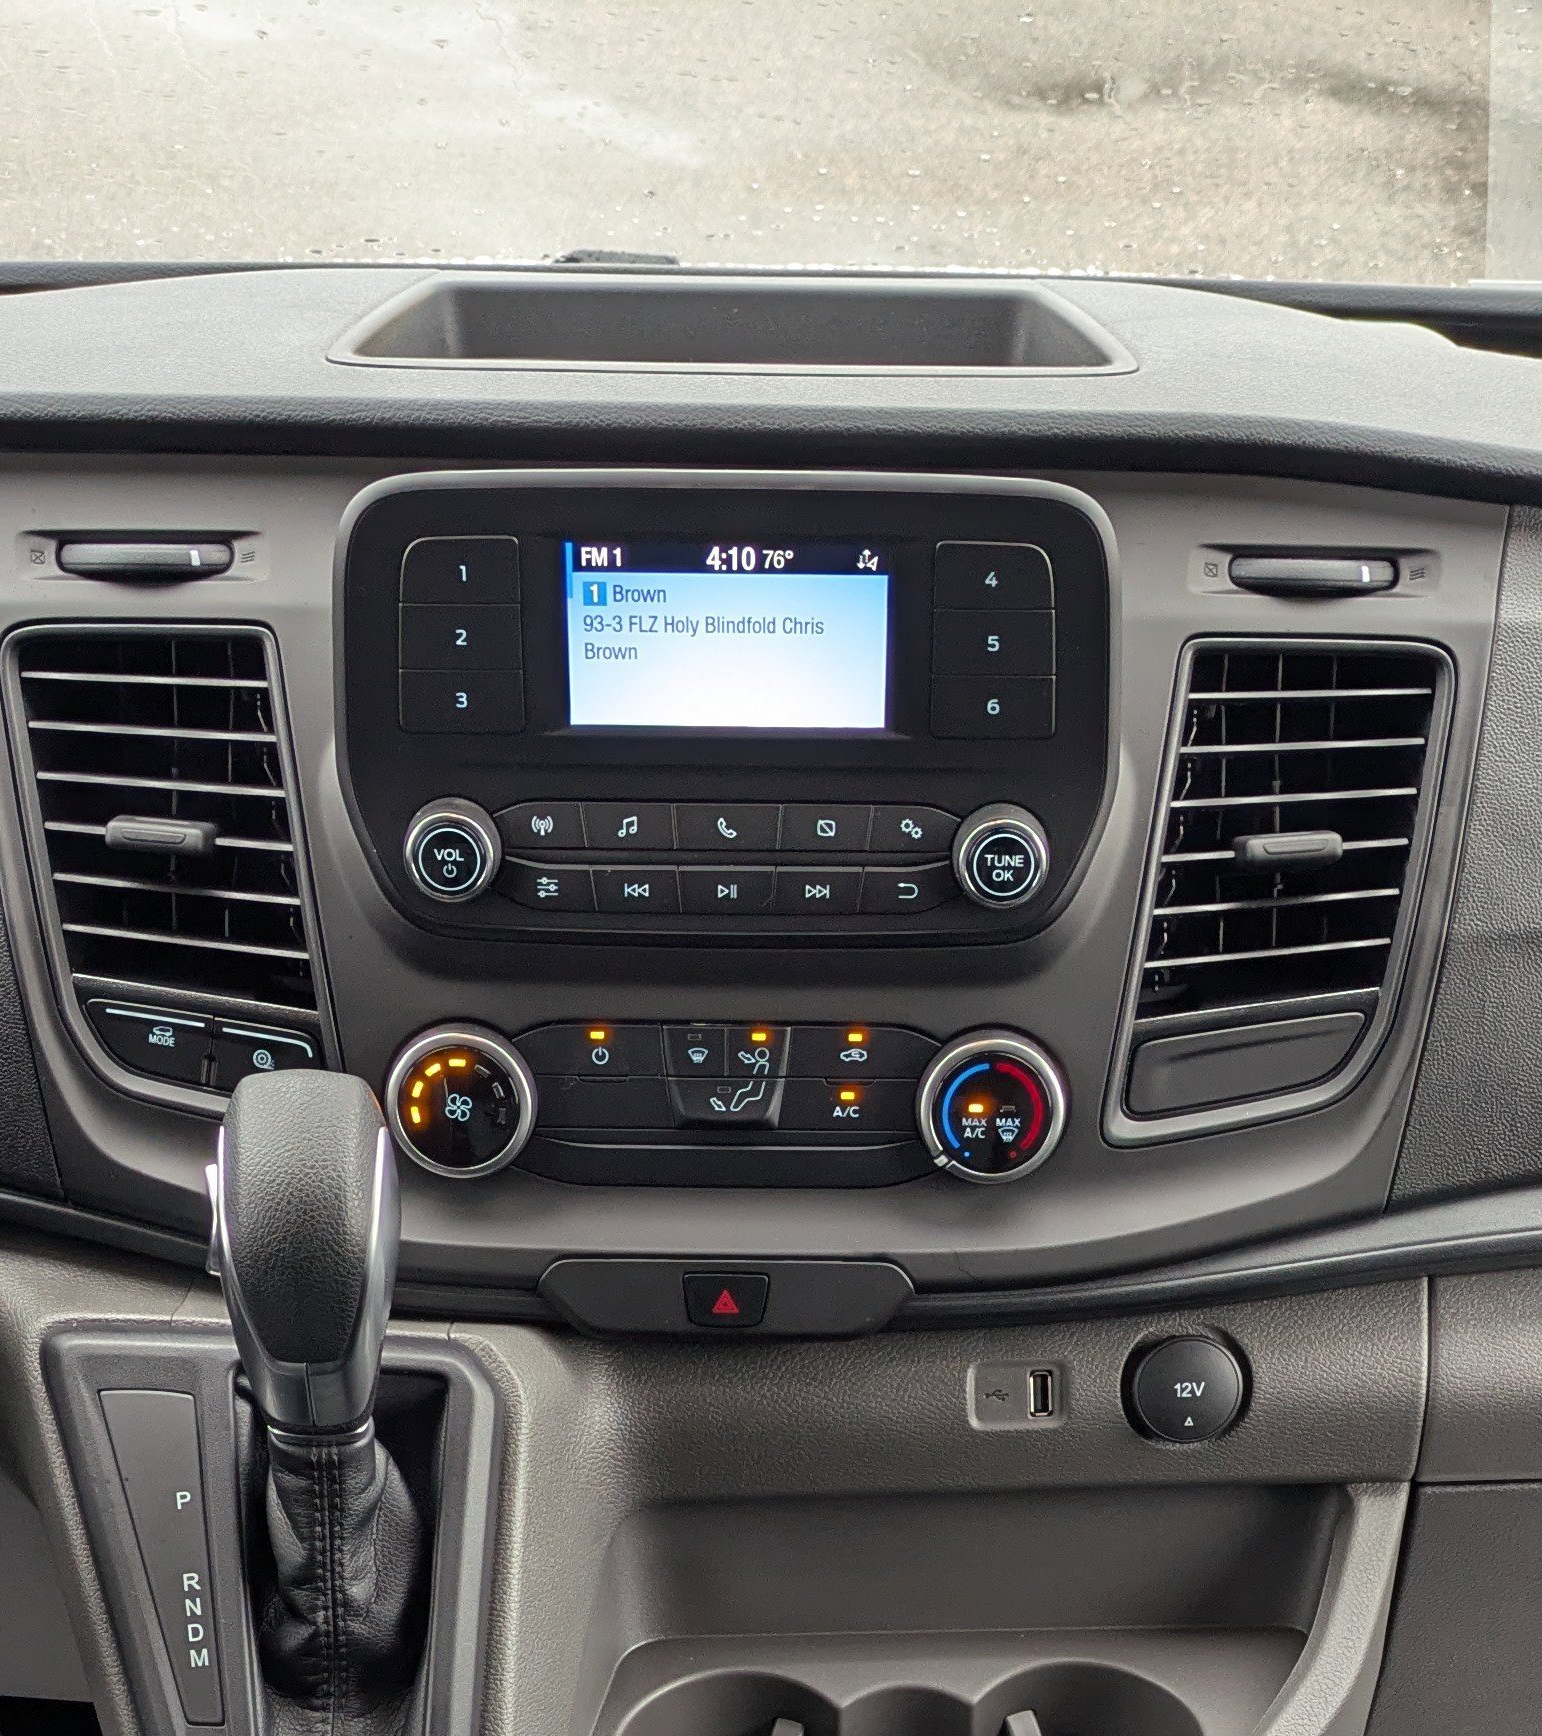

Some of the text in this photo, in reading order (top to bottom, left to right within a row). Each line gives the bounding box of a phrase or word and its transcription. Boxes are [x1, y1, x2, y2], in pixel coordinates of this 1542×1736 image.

[581, 547, 622, 567] FM 1
[706, 546, 756, 571] 4:10
[459, 564, 468, 583] 1
[984, 571, 998, 588] 4
[589, 584, 667, 603] 1 Brown
[583, 614, 825, 637] 93-3 FLZ Holy Blindfold Chris
[455, 629, 468, 646] 2
[986, 635, 1000, 652] 5
[584, 642, 638, 660] Brown
[455, 692, 468, 709] 3
[986, 698, 1000, 716] 6
[433, 849, 465, 862] VOL
[983, 854, 1025, 868] TUNE
[992, 869, 1015, 883] OK
[148, 1034, 176, 1048] MODE
[832, 1106, 860, 1118] A/C
[962, 1118, 987, 1127] MAX
[995, 1118, 1021, 1127] MAX
[963, 1127, 986, 1139] A/C
[1173, 1381, 1205, 1398] 12V
[176, 1491, 191, 1510] P
[183, 1573, 201, 1591] R
[185, 1598, 202, 1617] N
[188, 1624, 204, 1643] D
[190, 1649, 210, 1668] M
